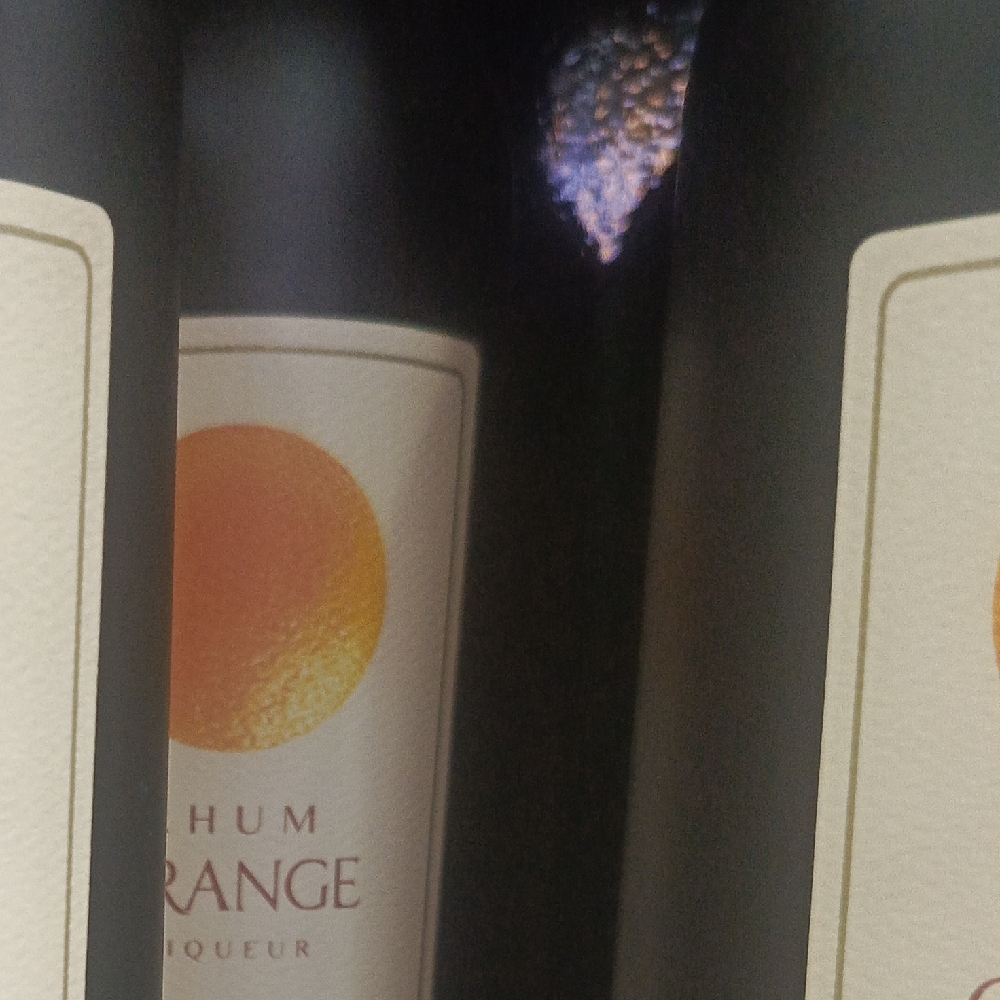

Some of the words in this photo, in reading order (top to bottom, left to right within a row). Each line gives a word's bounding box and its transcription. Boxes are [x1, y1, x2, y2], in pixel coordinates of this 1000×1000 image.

[189, 805, 315, 835] HUM
[165, 856, 360, 915] RANGE
[166, 938, 309, 963] IQUEUR
